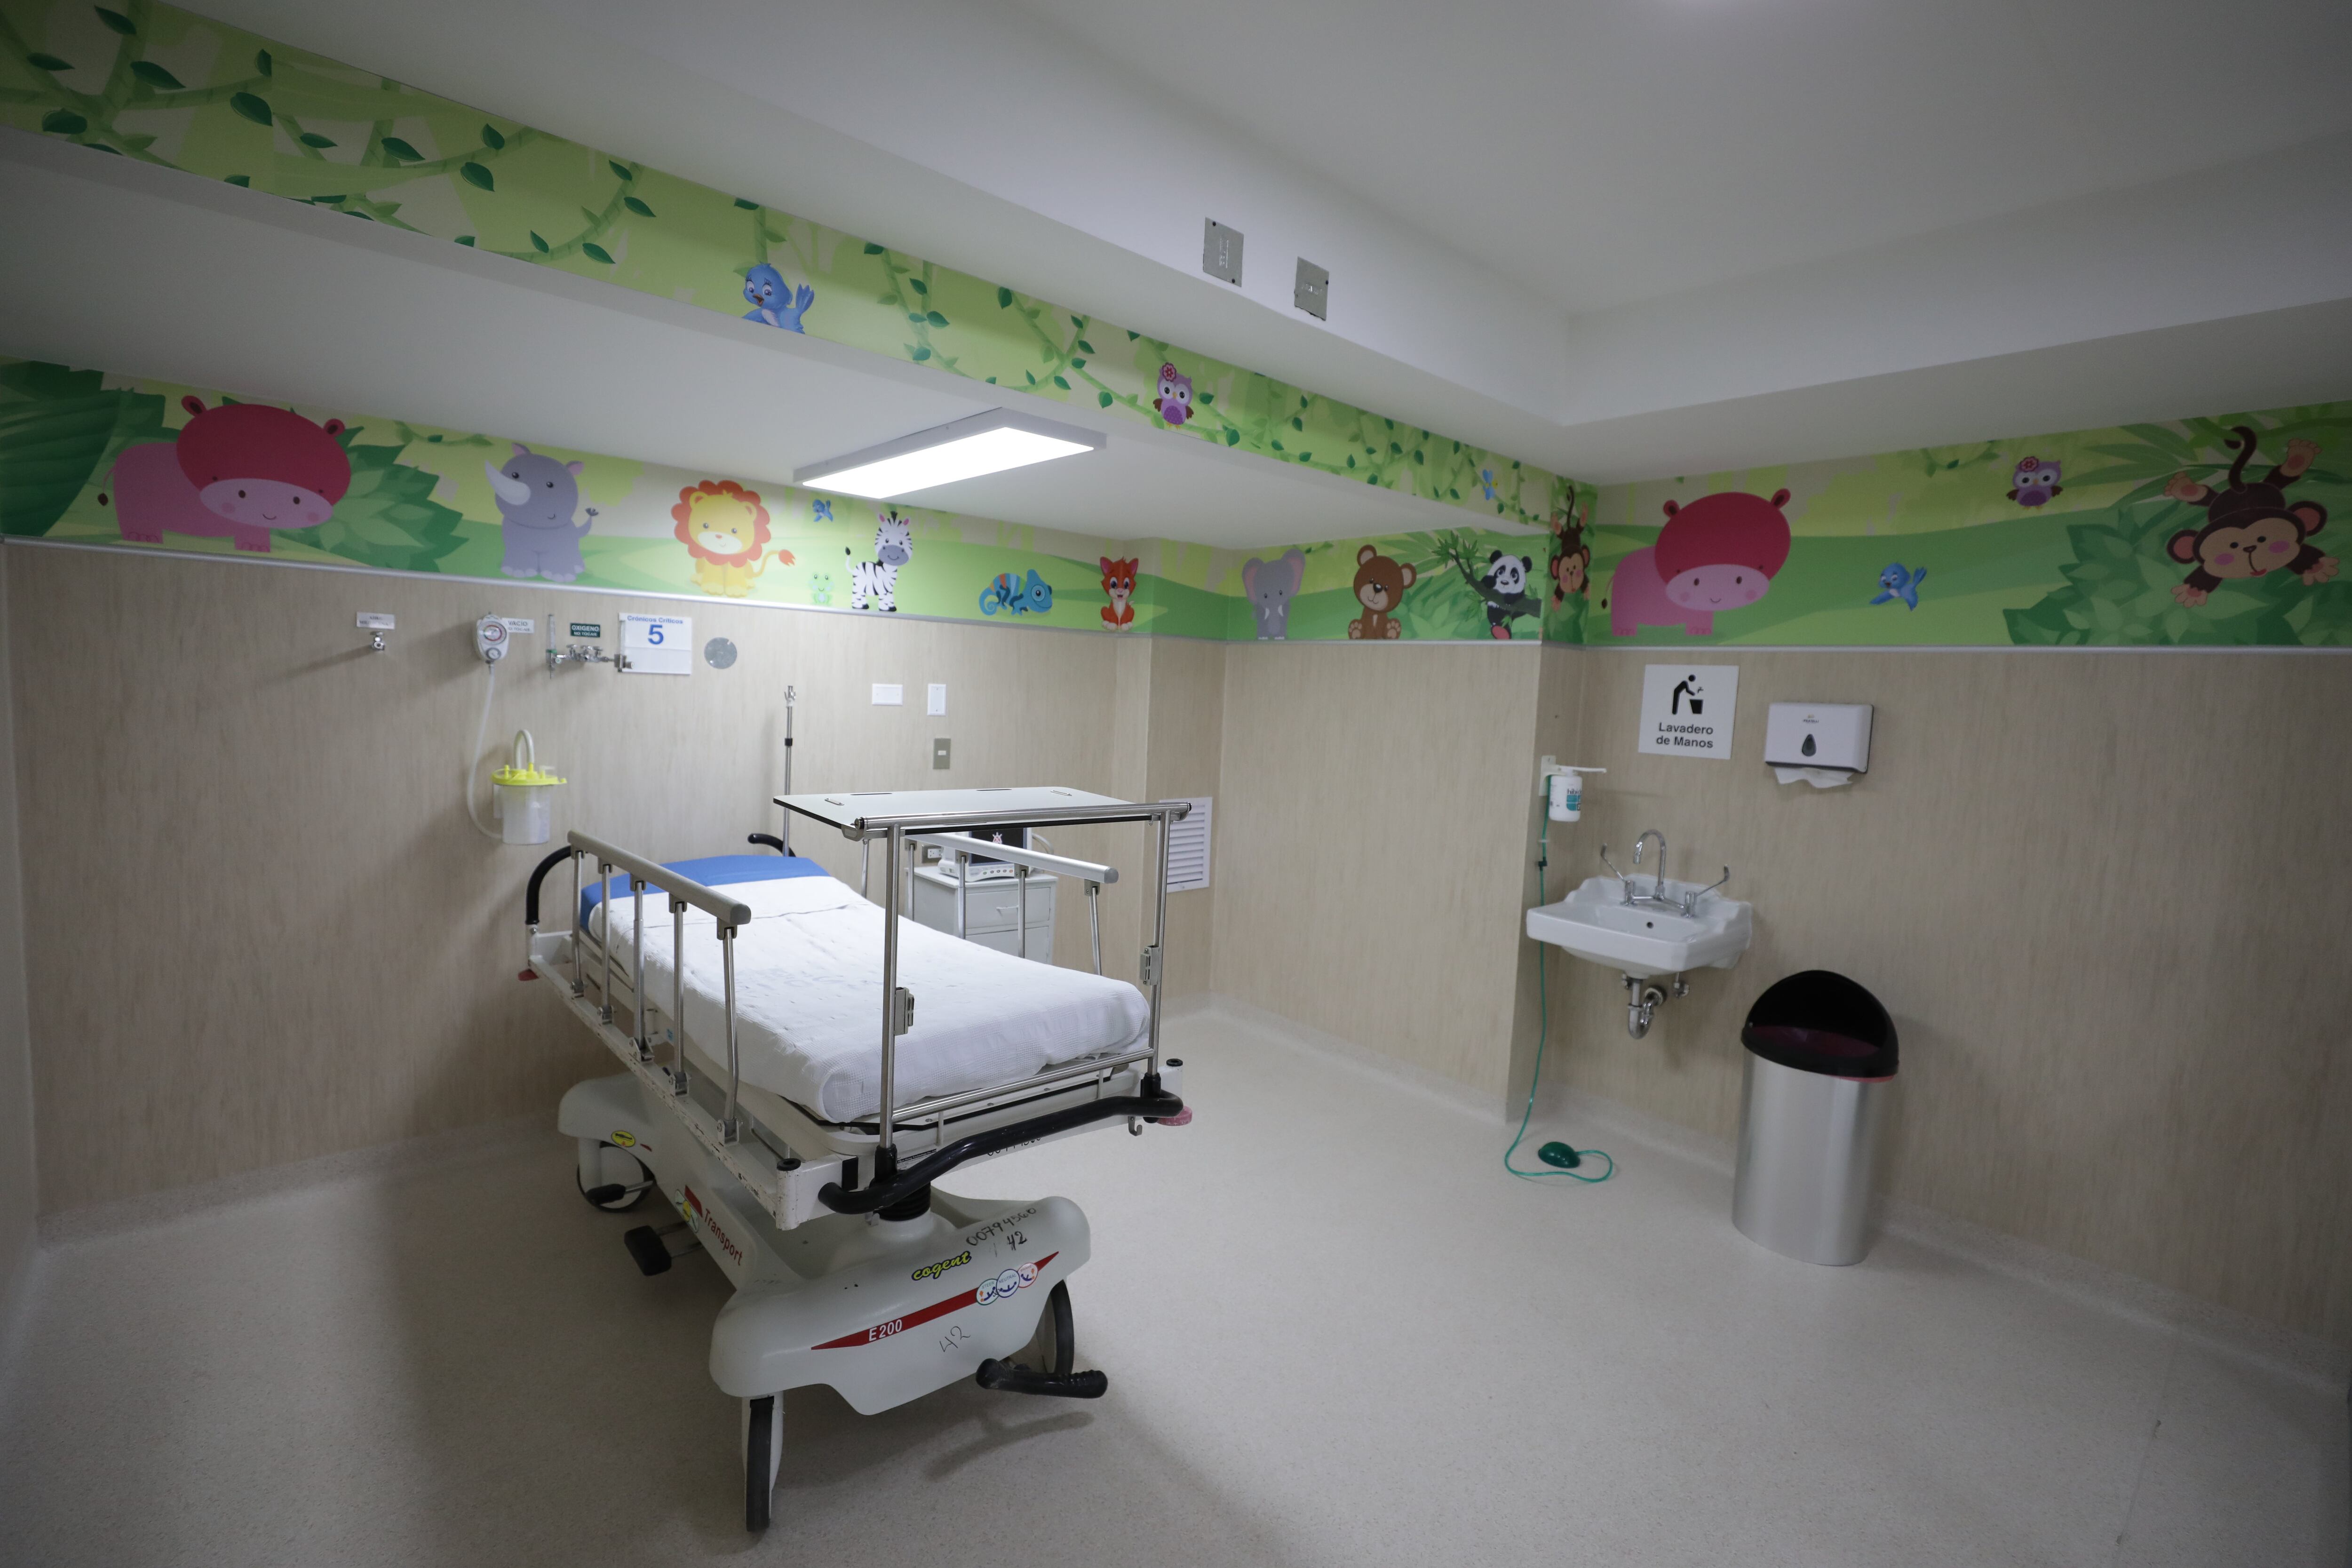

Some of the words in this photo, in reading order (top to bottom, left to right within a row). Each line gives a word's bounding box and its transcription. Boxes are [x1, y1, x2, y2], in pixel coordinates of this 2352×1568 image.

[647, 624, 664, 645] 5
[1659, 722, 1713, 734] Lavadero
[1656, 735, 1670, 745] de
[1674, 736, 1713, 748] Manos
[704, 1208, 742, 1266] Transport
[1007, 1231, 1027, 1250] 42
[912, 1250, 972, 1281] cogent
[998, 1274, 1017, 1283] NEUTRAL
